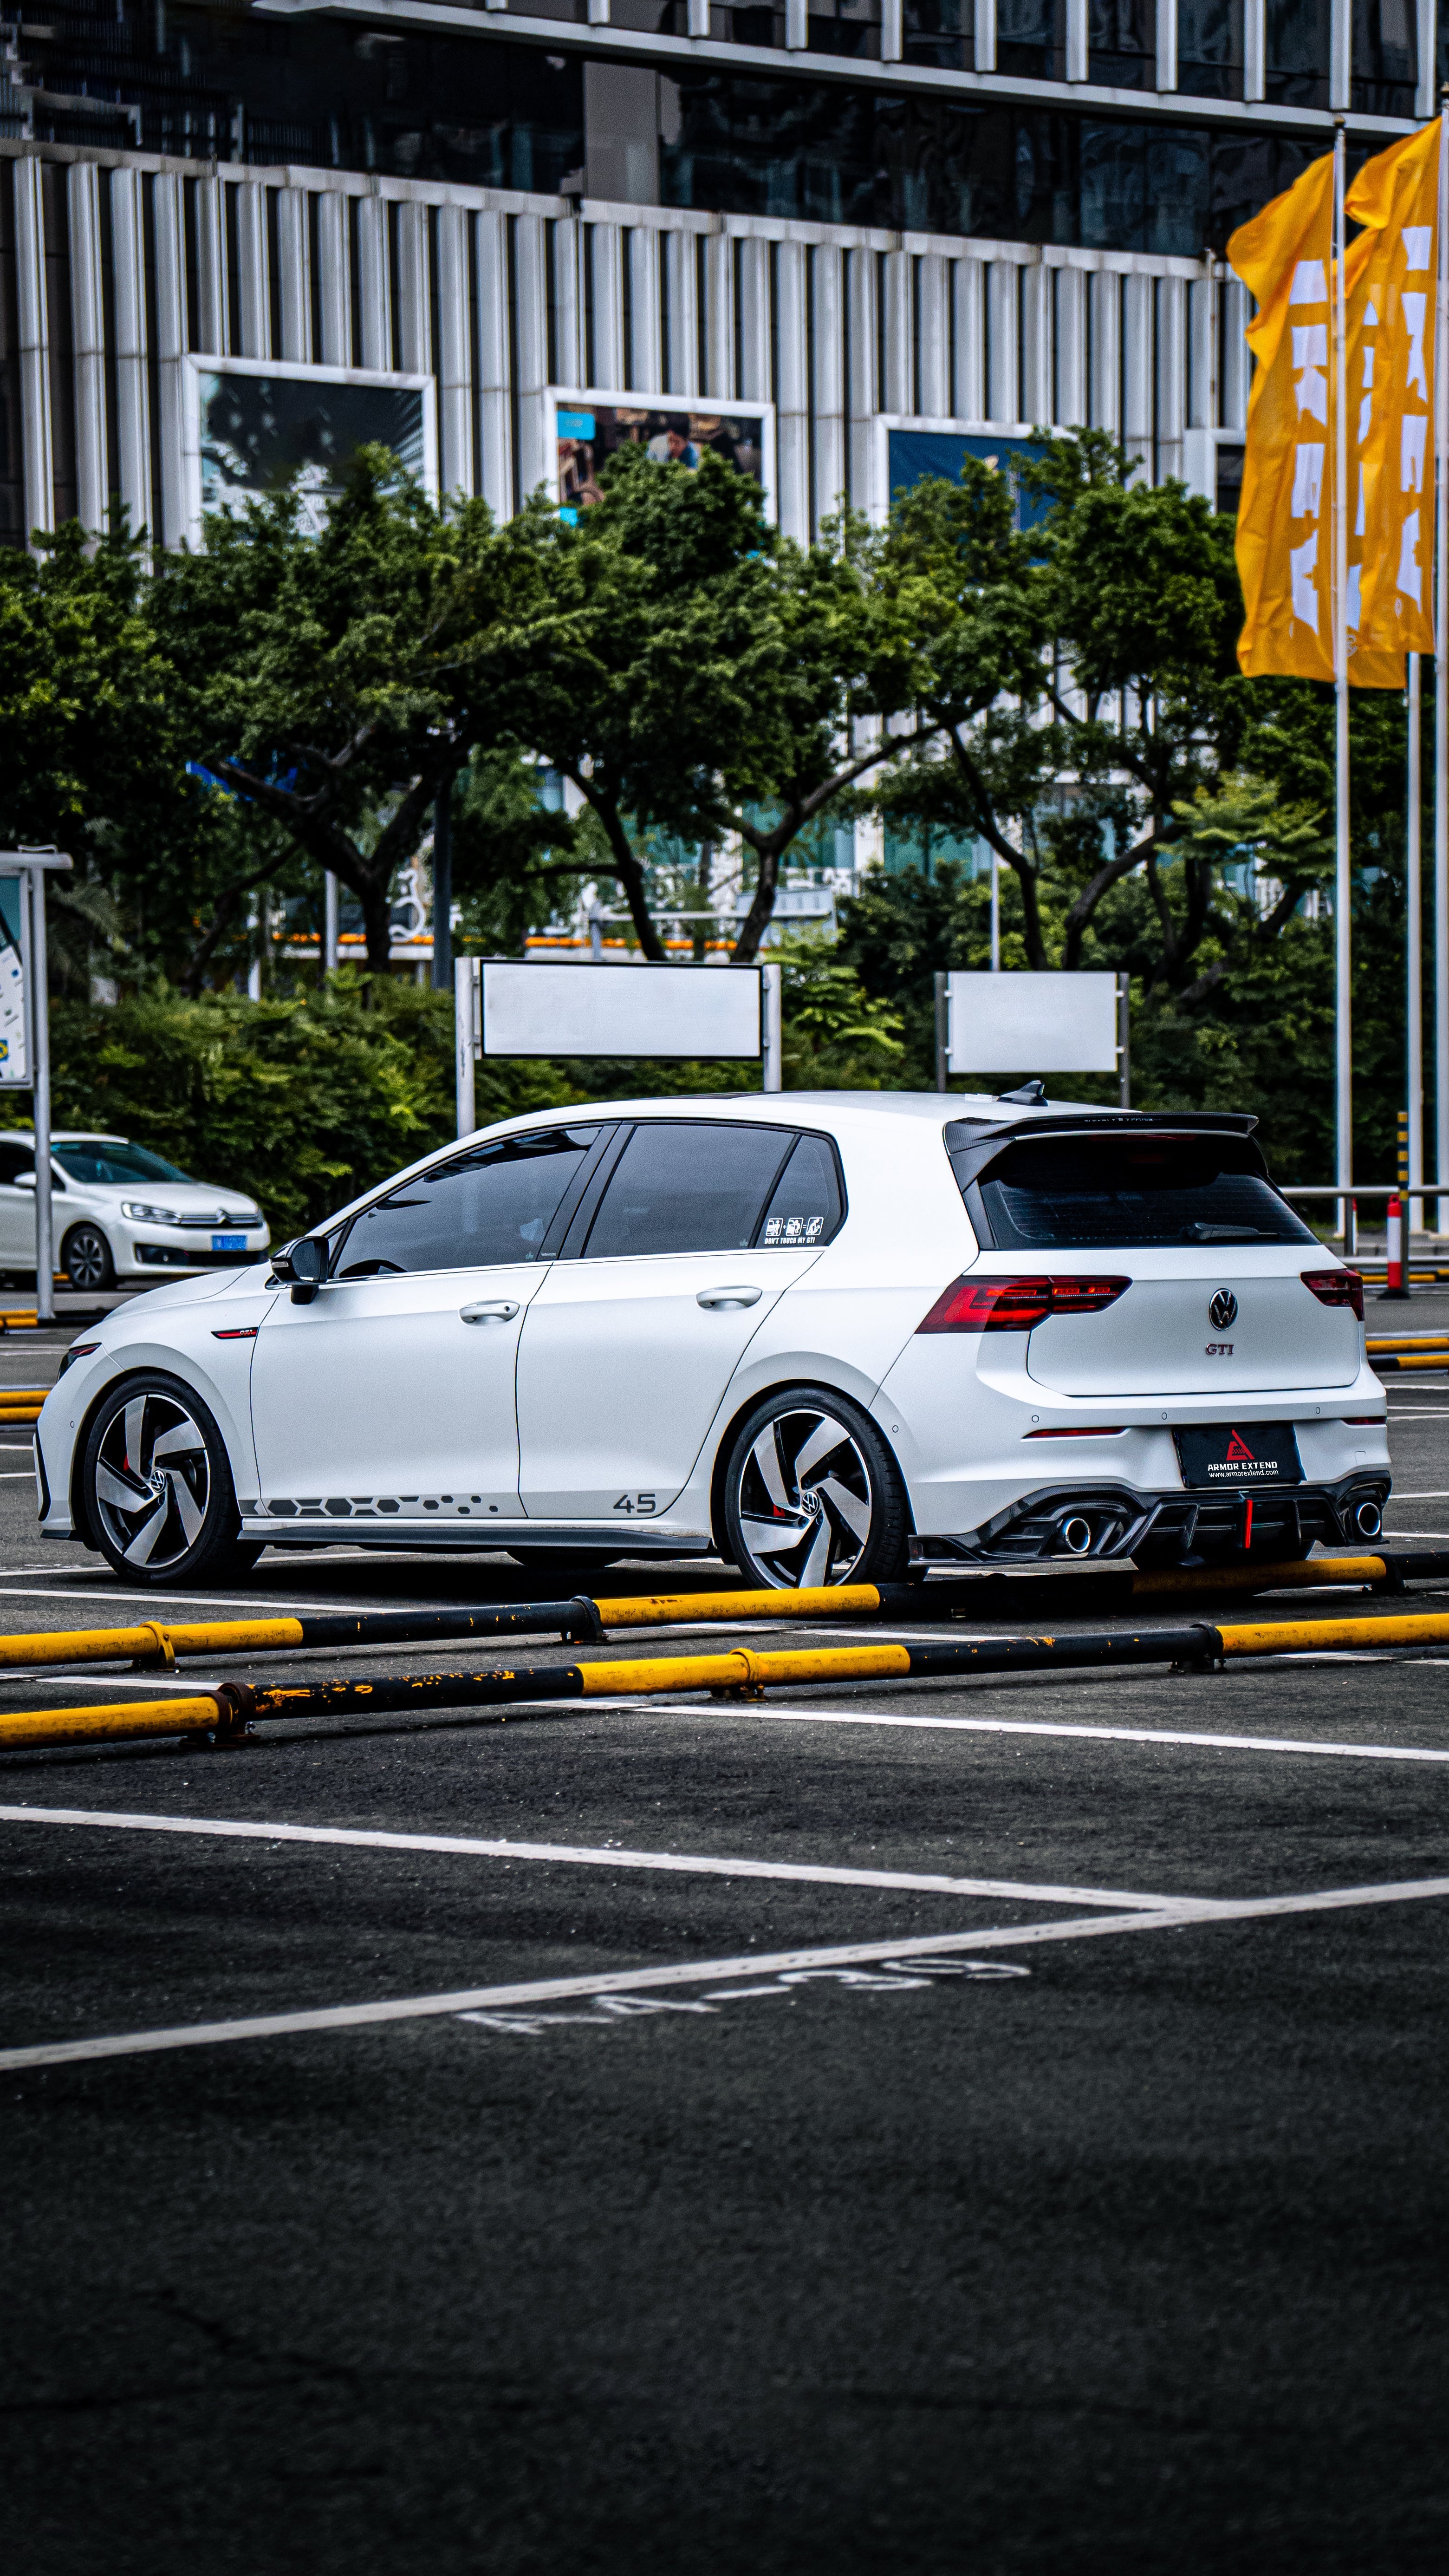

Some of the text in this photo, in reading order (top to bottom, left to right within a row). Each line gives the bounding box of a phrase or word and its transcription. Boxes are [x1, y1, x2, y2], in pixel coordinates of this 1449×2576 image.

[1206, 1343, 1235, 1355] GTI
[1241, 1461, 1278, 1470] EXTEND
[1209, 1469, 1279, 1478] www.armorextend.com
[613, 1493, 656, 1513] 45
